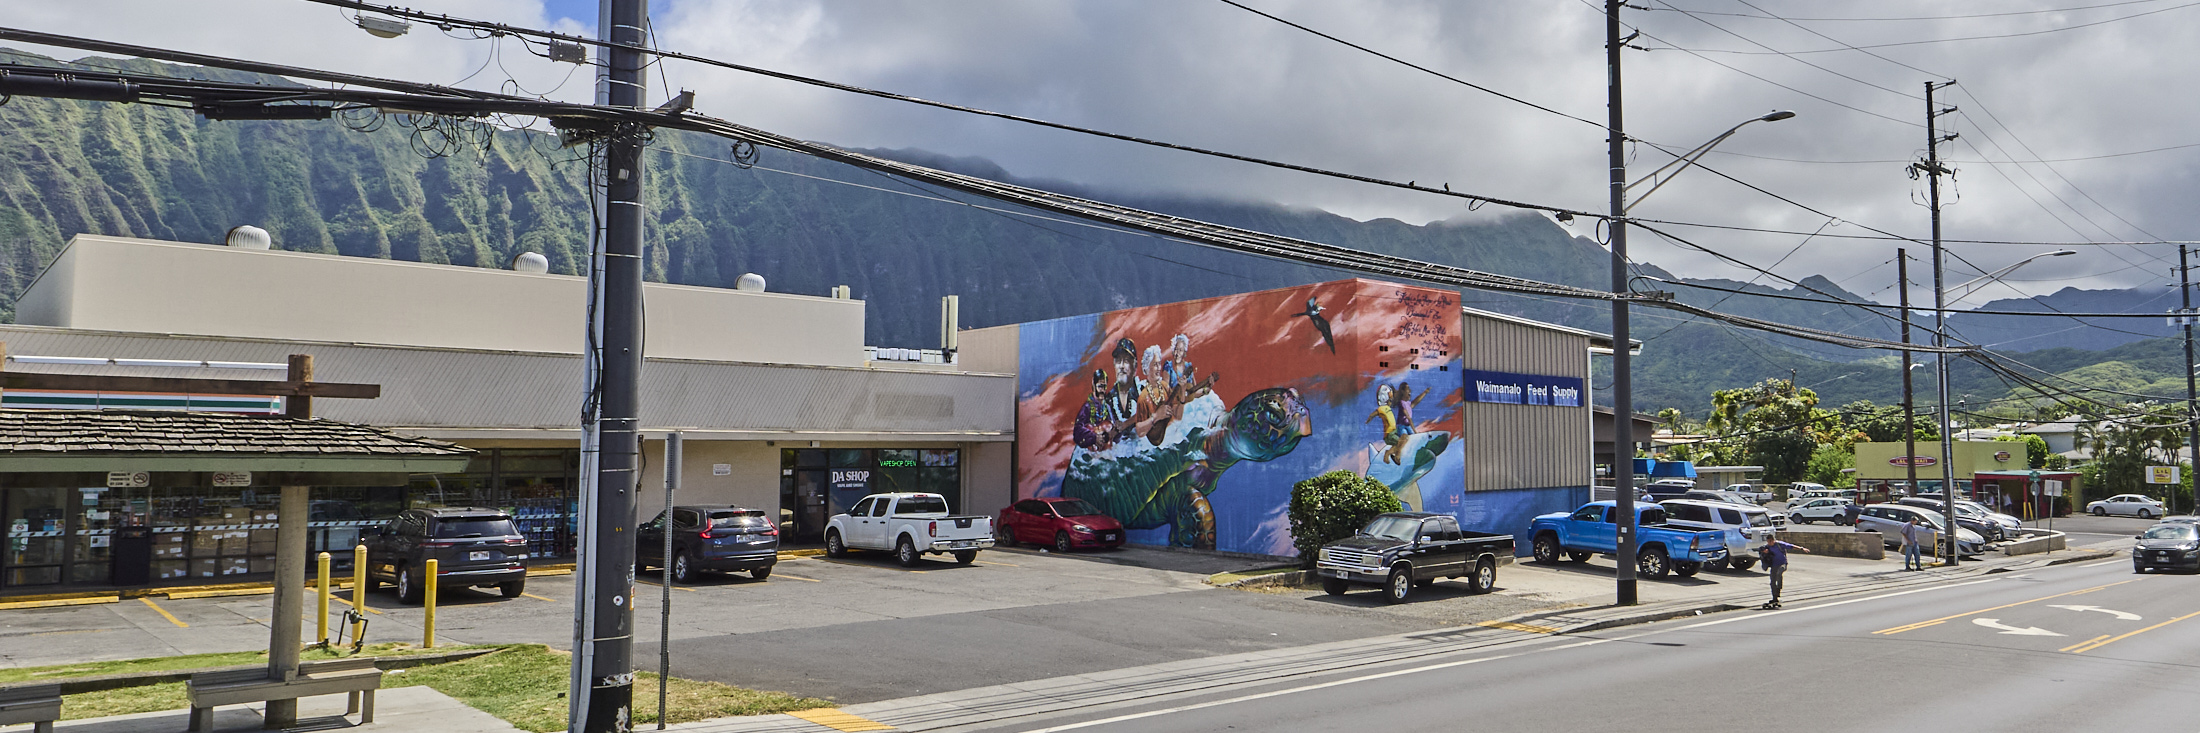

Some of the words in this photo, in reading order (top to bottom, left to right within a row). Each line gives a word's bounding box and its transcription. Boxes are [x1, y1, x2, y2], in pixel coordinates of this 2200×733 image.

[1476, 380, 1521, 395] Waimanalo
[1527, 384, 1547, 395] Feed
[1552, 385, 1578, 400] Supply
[832, 471, 845, 483] DA
[845, 471, 869, 482] SHOP
